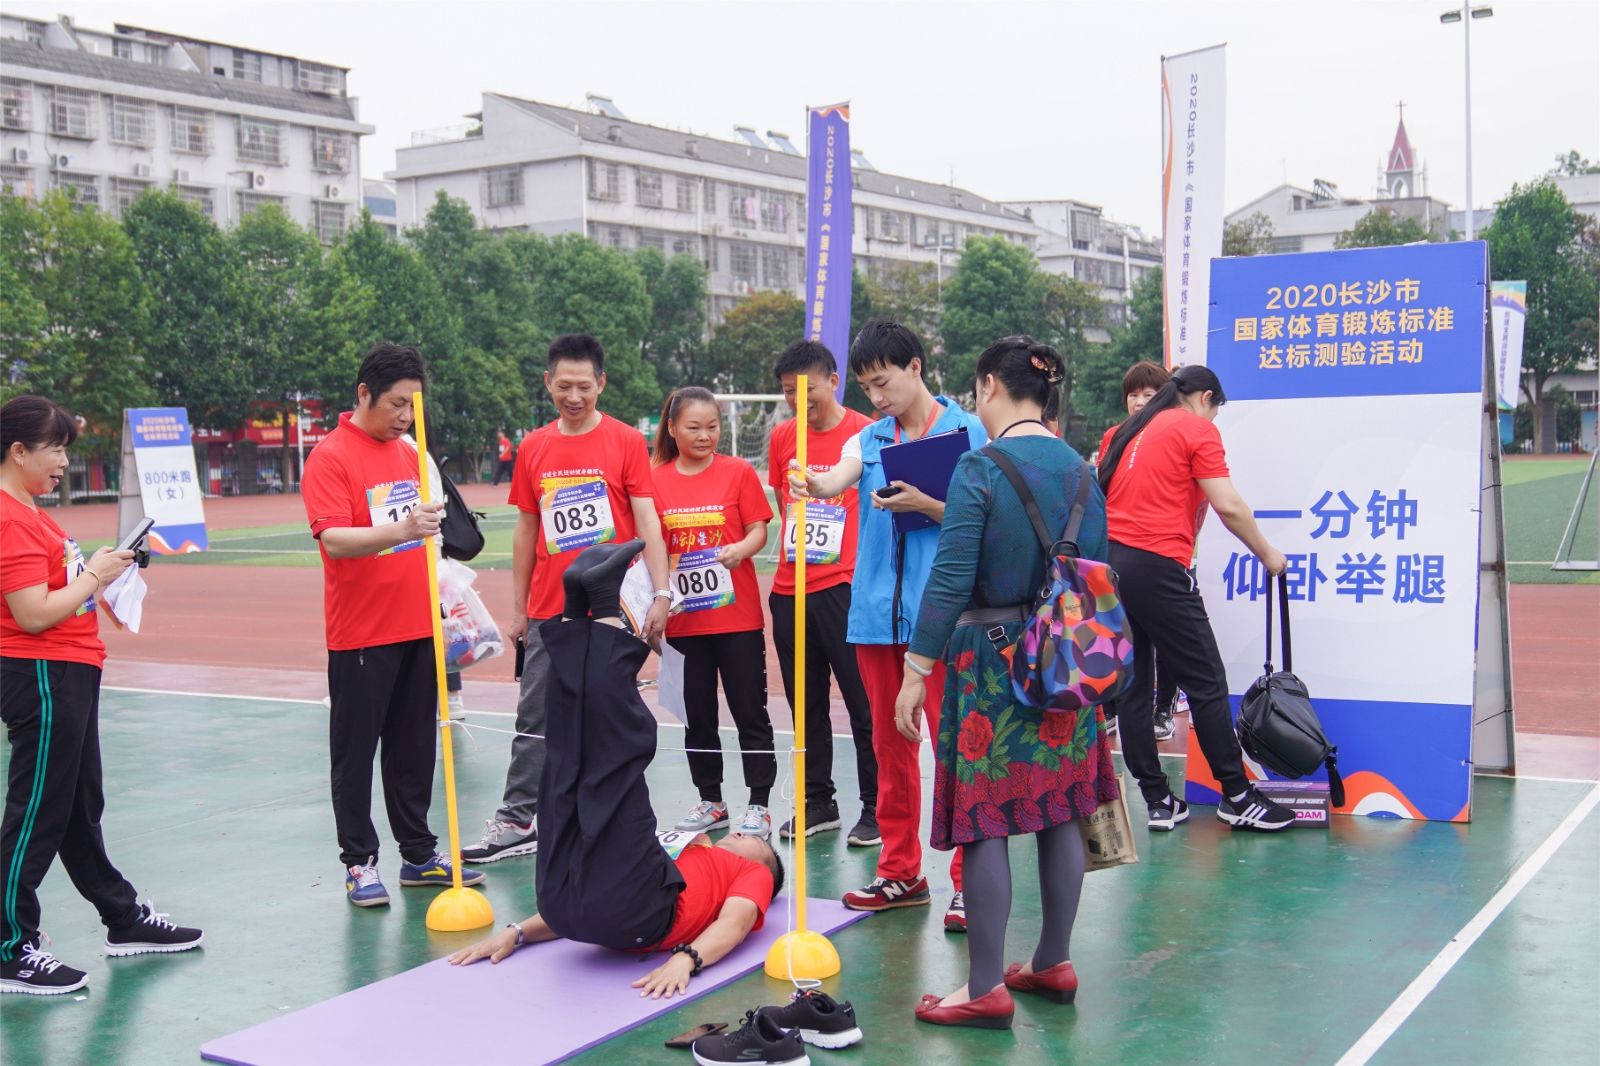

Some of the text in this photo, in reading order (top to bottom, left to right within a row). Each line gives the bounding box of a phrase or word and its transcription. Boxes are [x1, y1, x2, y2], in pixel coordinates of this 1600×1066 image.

[1178, 73, 1199, 367] 2020长沙市《国家体育锻炼标准》
[1265, 277, 1421, 310] 2020长沙市
[1233, 306, 1455, 342] 国家体育锻炼标准
[1258, 338, 1424, 370] 达标测验活动
[144, 470, 192, 485] 800米跑
[388, 502, 418, 522] 12
[553, 504, 598, 534] 083
[1253, 488, 1418, 541] 一分钟
[677, 568, 719, 596] 080
[1222, 551, 1447, 604] 仰卧举腿
